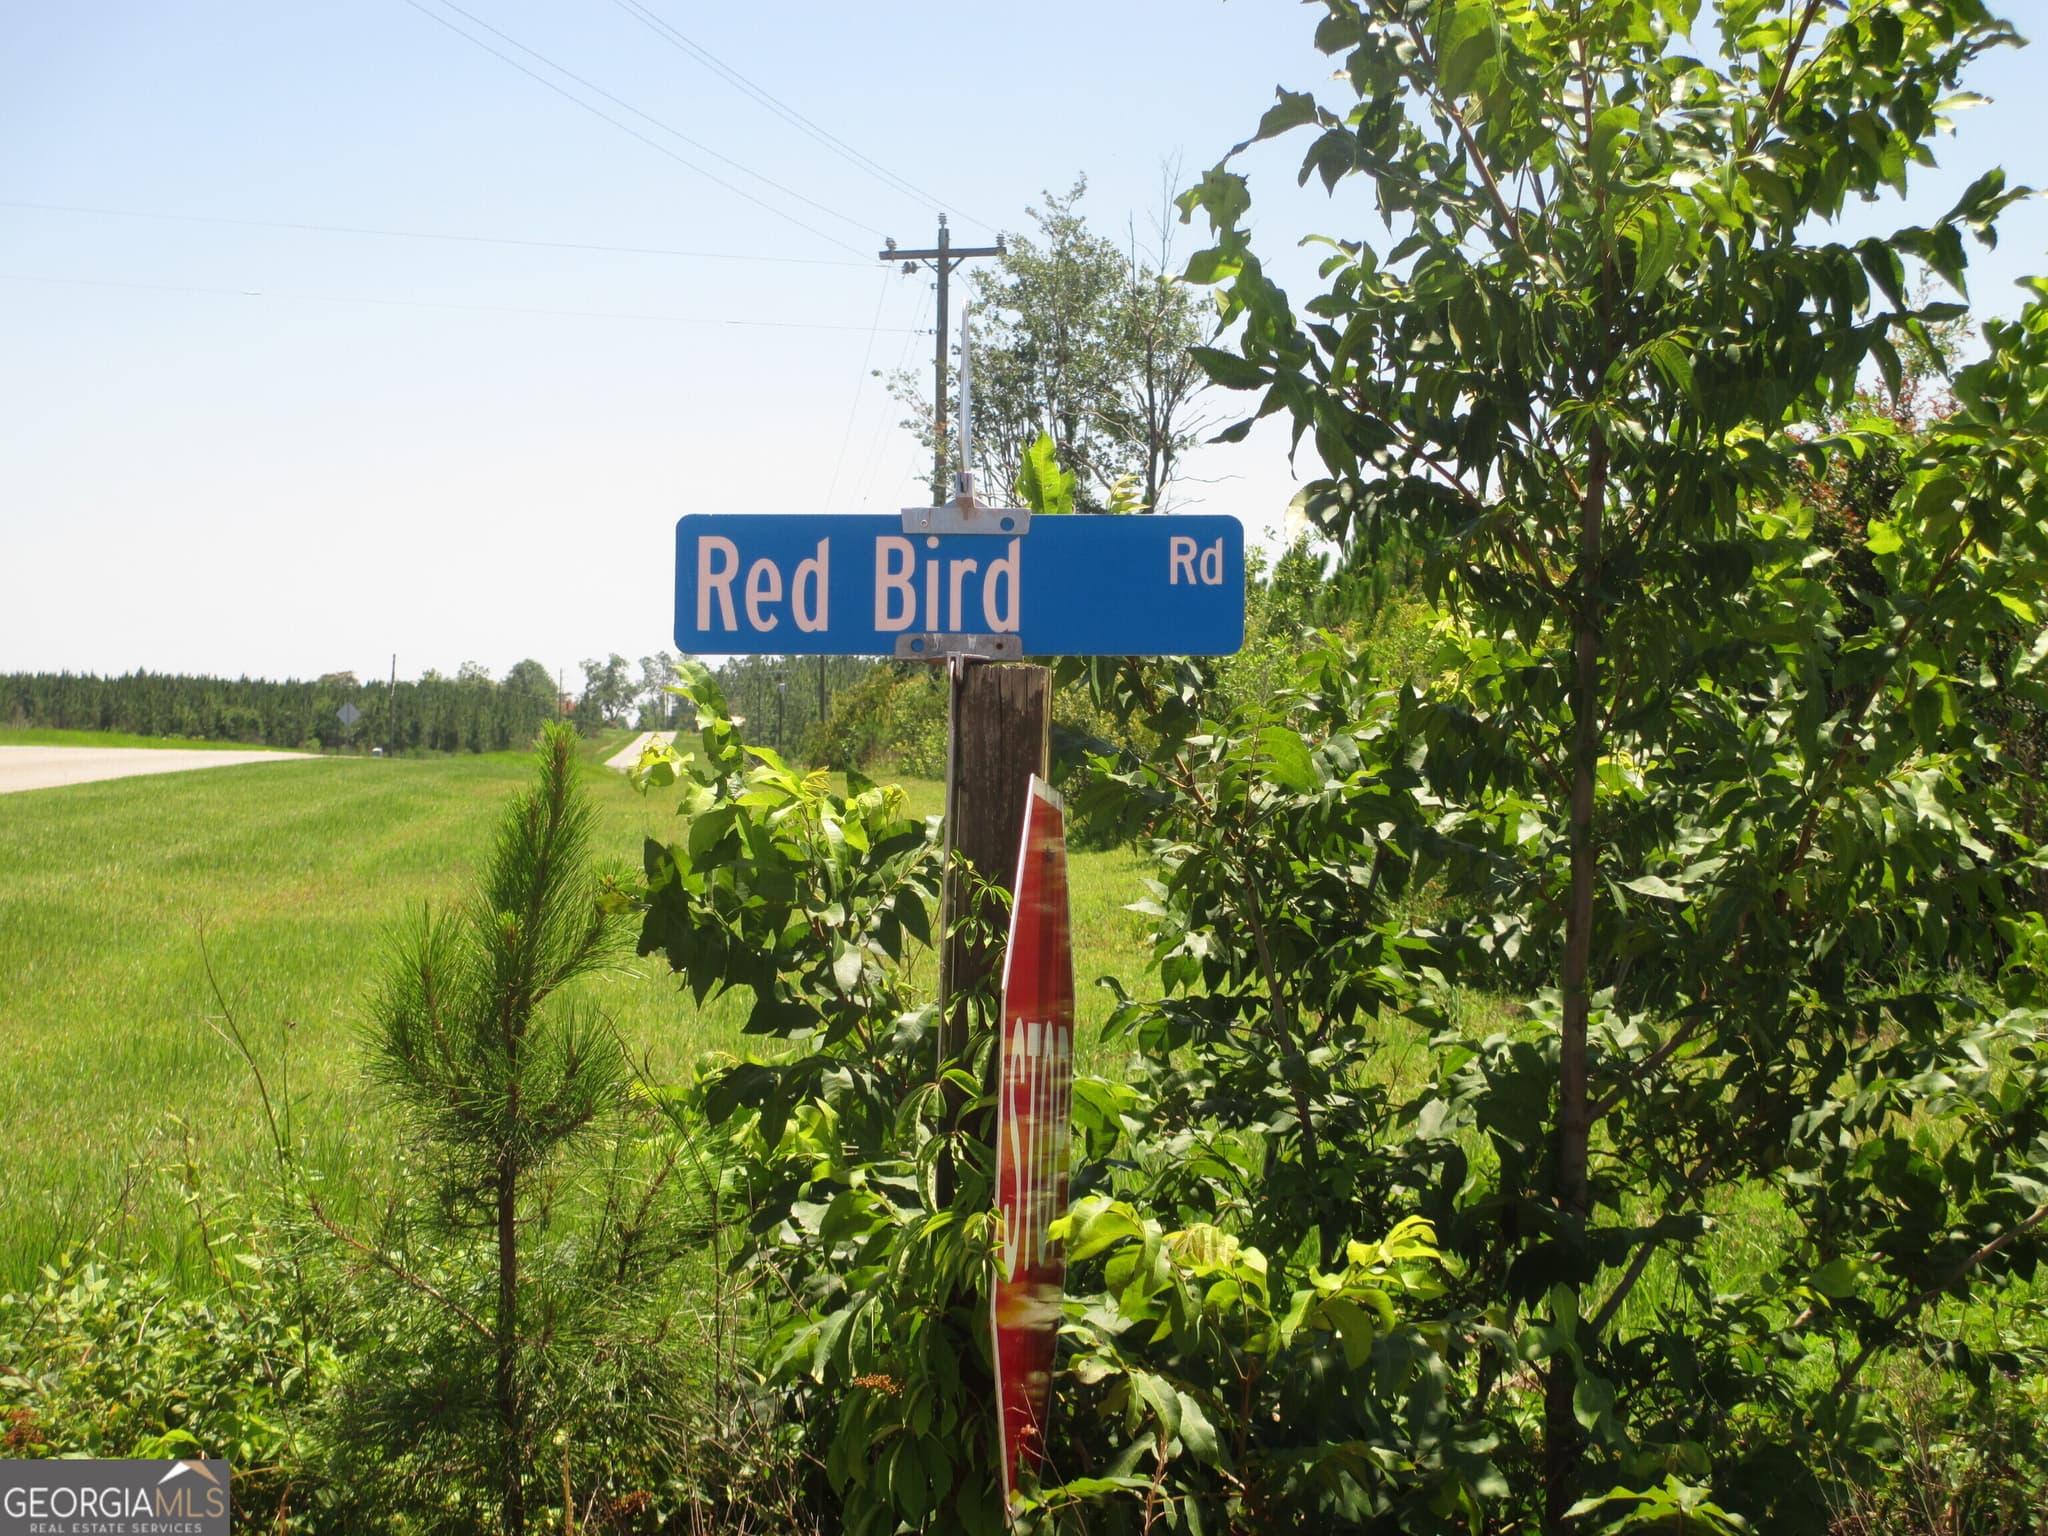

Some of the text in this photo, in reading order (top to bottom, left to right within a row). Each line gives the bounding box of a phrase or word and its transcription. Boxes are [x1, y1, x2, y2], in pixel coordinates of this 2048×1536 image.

[696, 535, 1223, 632] Red Bird Rd
